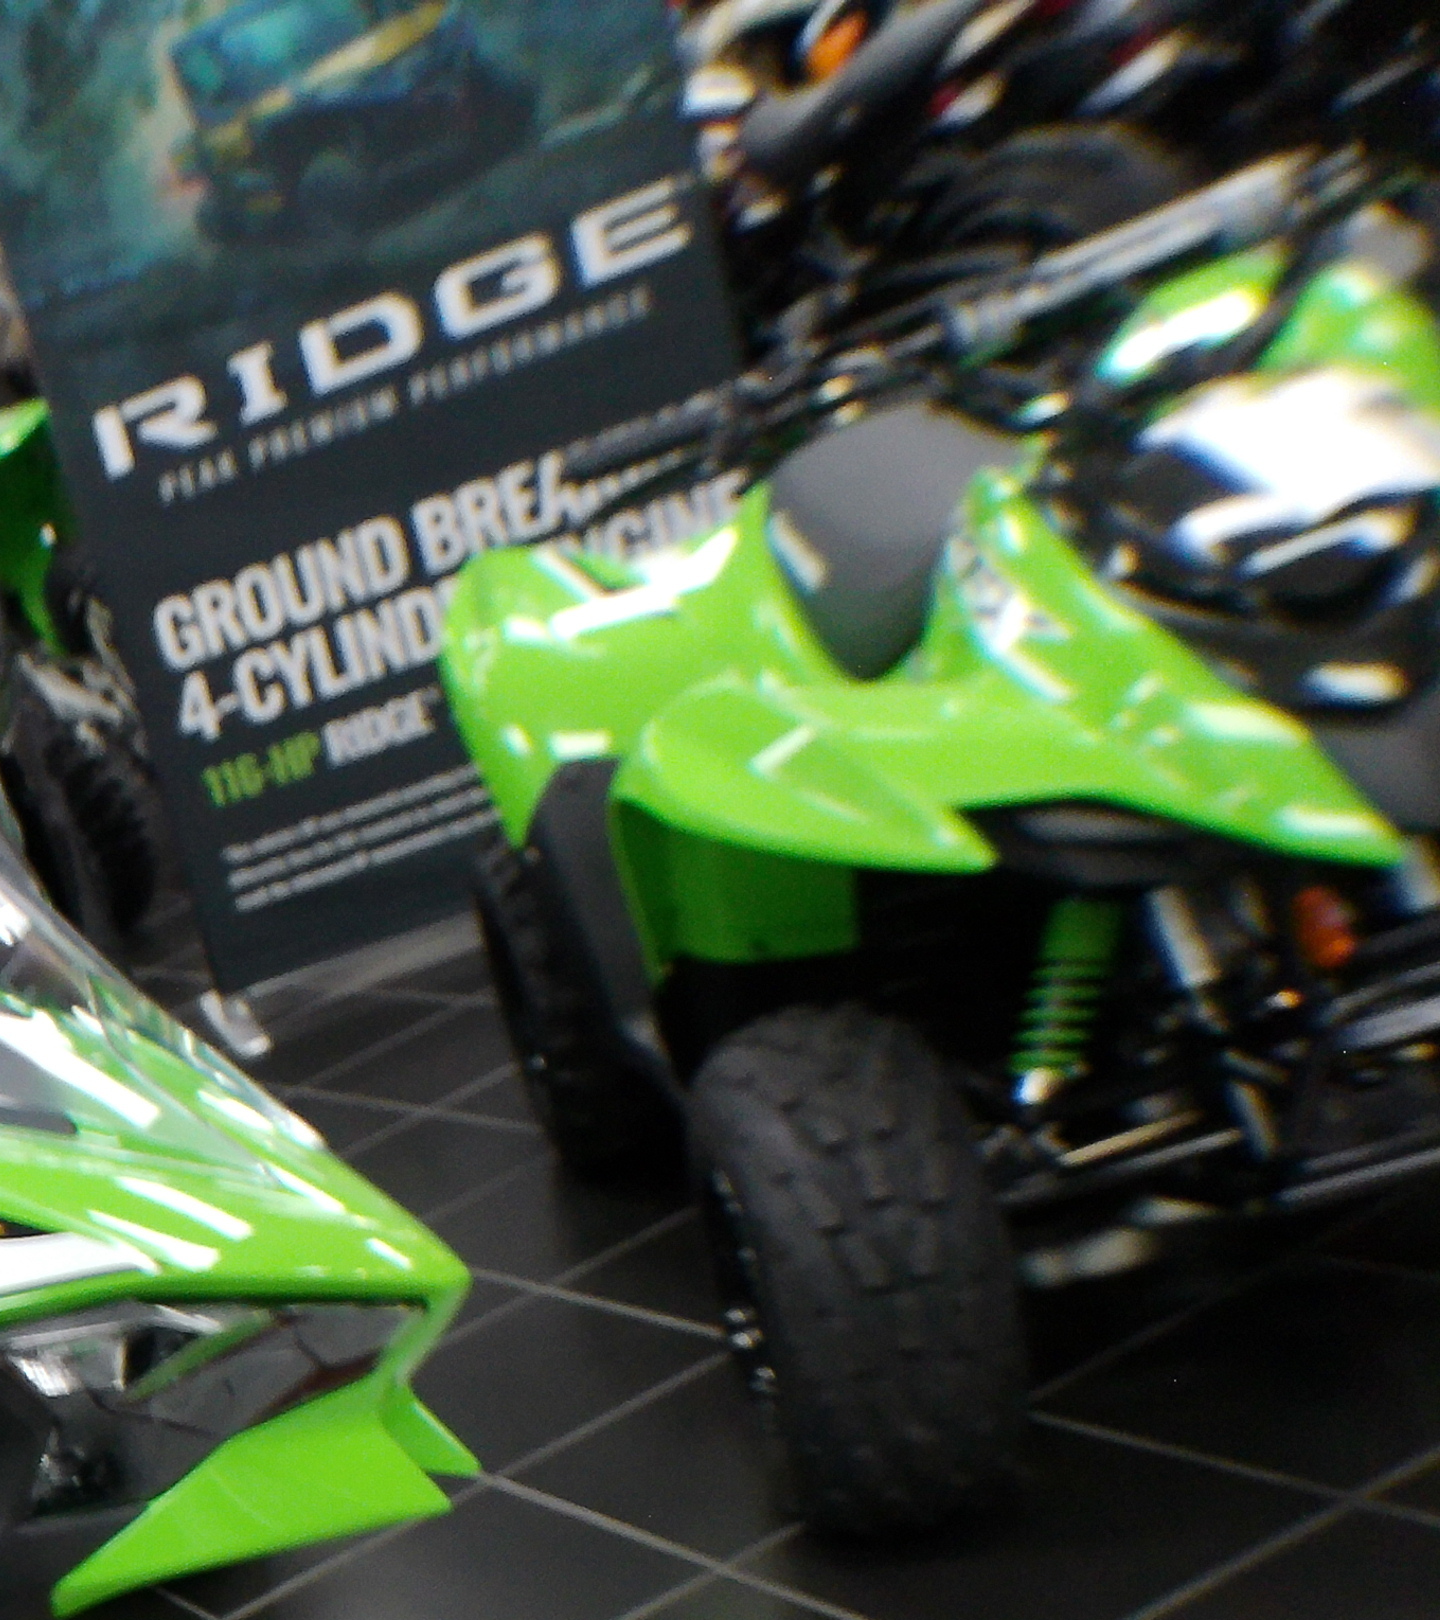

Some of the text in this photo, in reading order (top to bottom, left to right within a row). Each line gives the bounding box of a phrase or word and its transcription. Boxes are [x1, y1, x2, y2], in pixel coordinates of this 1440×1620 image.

[92, 176, 693, 480] RIDGE
[247, 384, 399, 472] PREMIUM
[407, 282, 654, 406] PERFORMANCE
[153, 514, 411, 672] GROUND
[178, 576, 458, 742] 4-CYLIND
